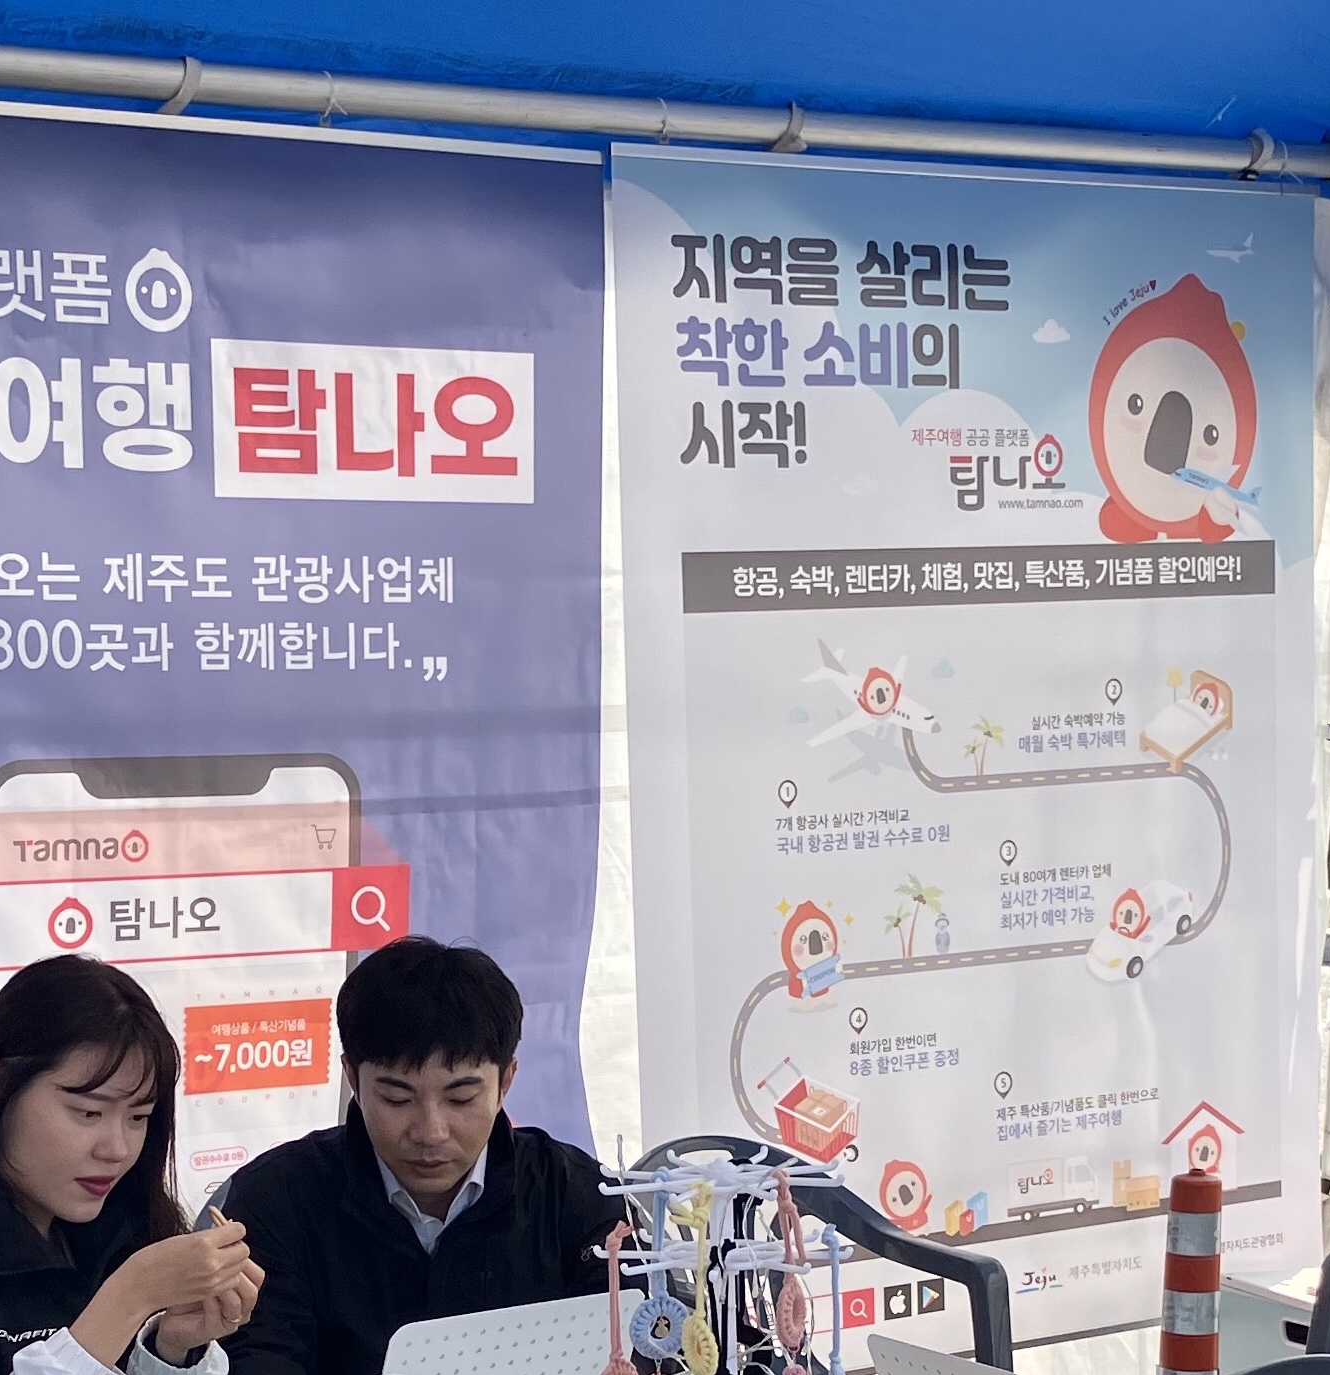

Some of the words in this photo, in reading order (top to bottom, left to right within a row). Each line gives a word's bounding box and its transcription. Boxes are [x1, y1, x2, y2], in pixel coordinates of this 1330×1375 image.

[670, 233, 840, 307] 지역을
[856, 240, 1011, 312] 살리는
[1109, 297, 1129, 319] love
[676, 315, 789, 388] 착한
[803, 321, 961, 391] 소비의
[232, 366, 519, 478] 탐나오
[680, 399, 808, 469] 시작!
[911, 428, 962, 447] 제주여행
[965, 428, 991, 447] 공공
[994, 428, 1031, 448] 플랫폼
[949, 433, 1067, 512] 탐나오
[997, 497, 1084, 511] www.tamnao.com
[102, 554, 233, 602] 제주도
[251, 554, 456, 604] 관광사업체
[732, 566, 785, 600] 항공,
[789, 565, 840, 597] 숙박,
[845, 563, 917, 595] 렌터카,
[921, 561, 969, 593] 체험,
[973, 560, 1020, 592] 맛집,
[1024, 558, 1091, 590] 특산품,
[1094, 556, 1154, 587] 기념품
[1158, 553, 1244, 585] 할인예약!
[1032, 714, 1061, 730] 실시간
[1064, 712, 1103, 729] 숙박예약
[1106, 711, 1126, 726] 가능
[1018, 734, 1044, 753] 매월
[1048, 733, 1072, 751] 숙박
[1076, 729, 1126, 750] 특가혜택
[775, 816, 793, 831] 7개
[796, 814, 829, 831] 항공사
[832, 811, 864, 828] 실시간
[867, 809, 910, 826] 가격비교
[776, 835, 803, 855] 국내
[808, 832, 848, 854] 항공권
[852, 829, 880, 850] 발권
[883, 827, 923, 848] 수수료
[1000, 872, 1020, 887] 도내
[1092, 863, 1112, 879] 업체
[1000, 889, 1038, 909] 실시간
[109, 896, 221, 941] 탐나오
[1000, 910, 1038, 931] 최저가
[1041, 908, 1067, 928] 예약
[1071, 906, 1096, 925] 가능
[849, 1037, 892, 1056] 회원가입
[895, 1032, 937, 1050] 한번이면
[850, 1058, 873, 1077] 8종
[877, 1051, 930, 1075] 할인쿠폰
[934, 1047, 960, 1068] 증정
[996, 1105, 1017, 1122] 제주
[1120, 1087, 1160, 1106] 한번으로
[997, 1120, 1033, 1142] 집에서
[1036, 1117, 1072, 1137] 즐기는
[1075, 1109, 1123, 1131] 제주여행
[1021, 1267, 1057, 1291] Jeju
[1068, 1256, 1143, 1280] 제주특별자치도
